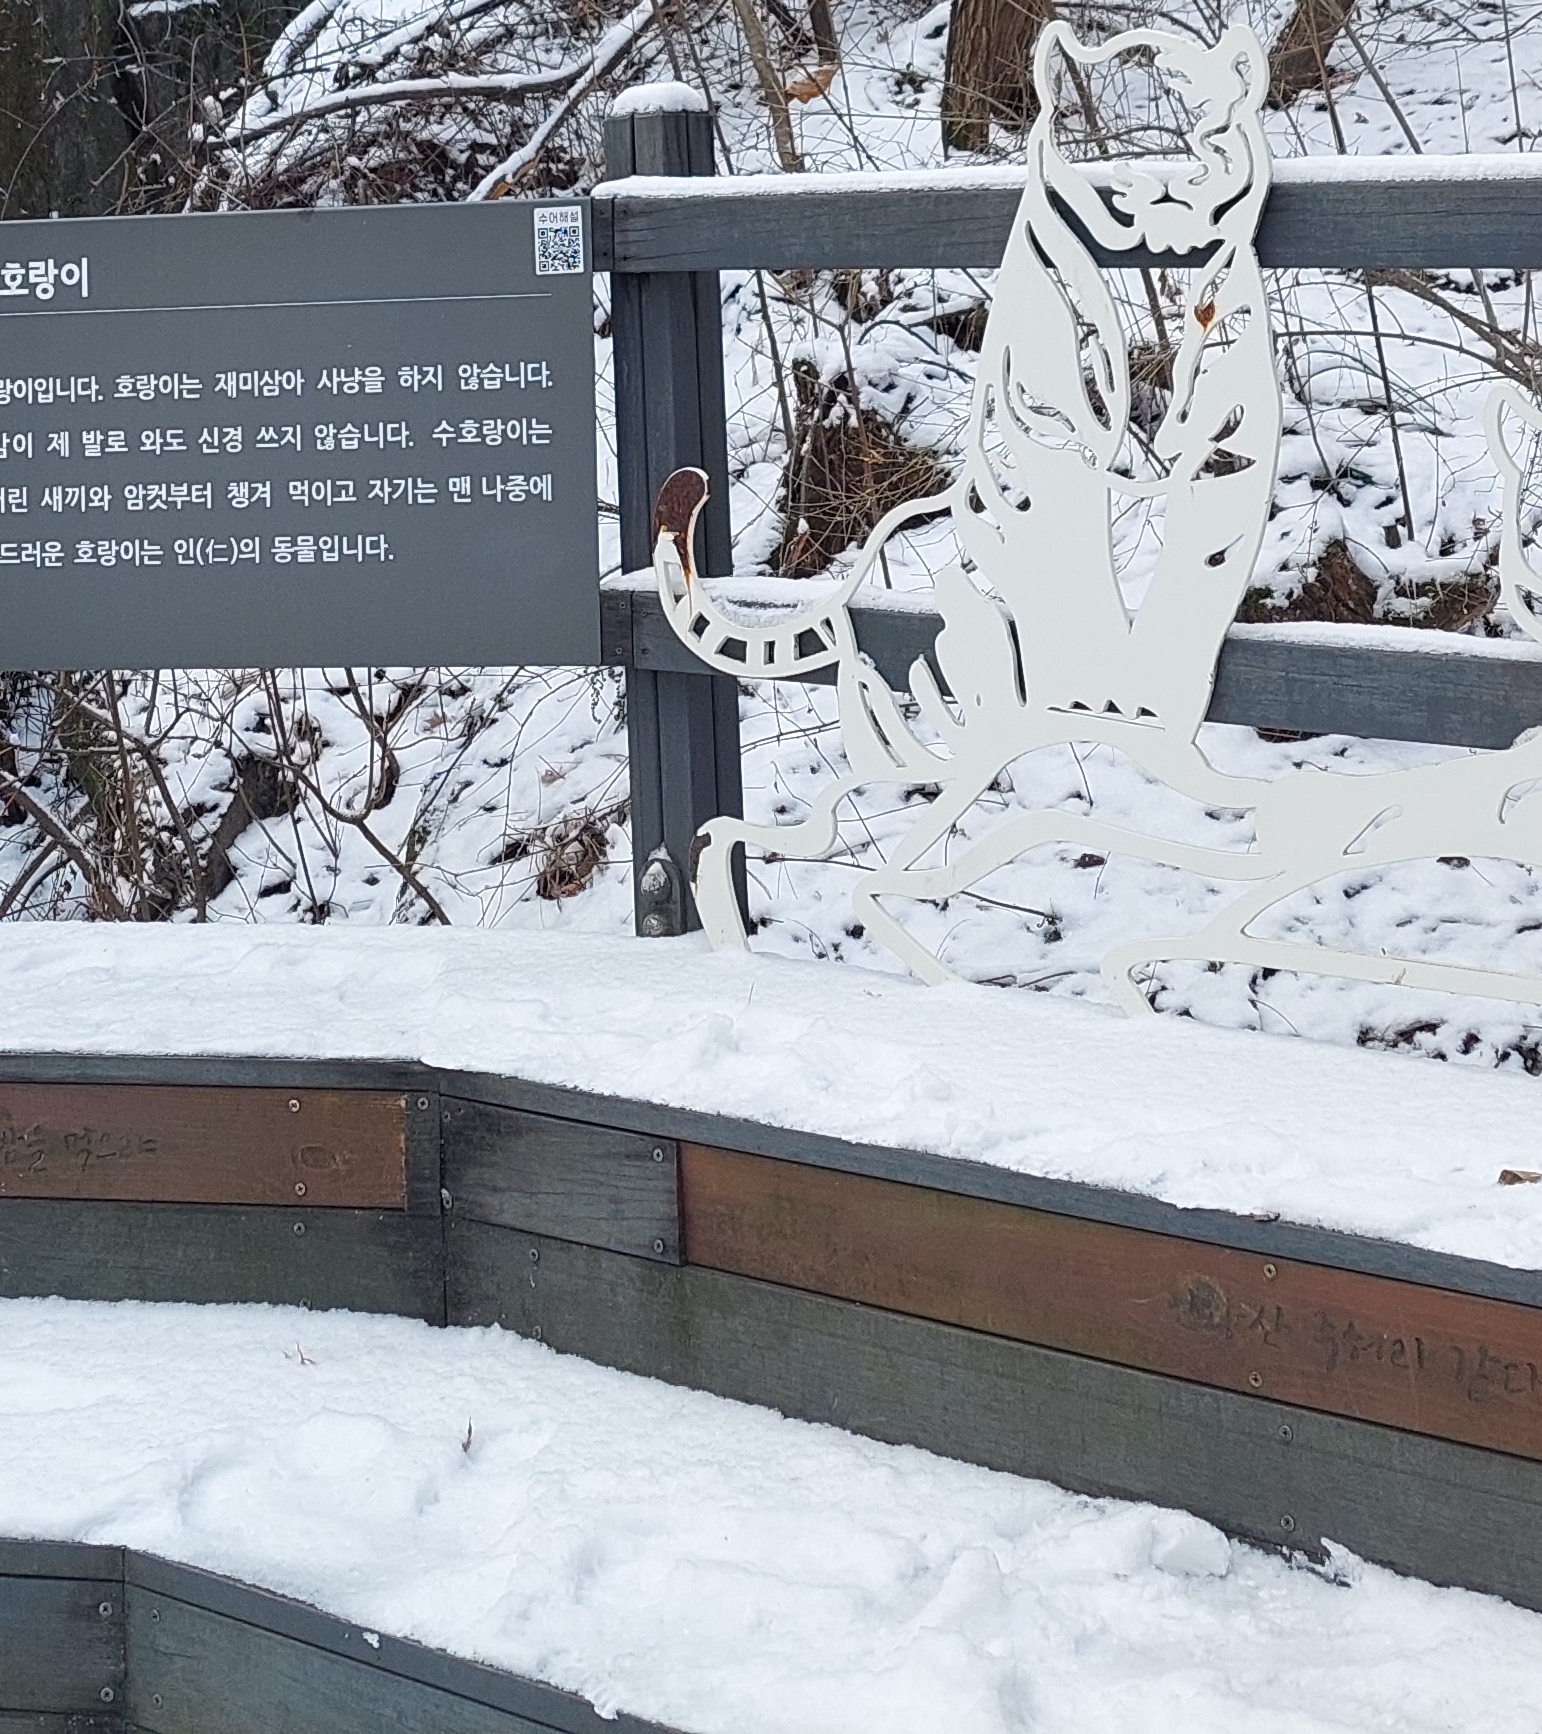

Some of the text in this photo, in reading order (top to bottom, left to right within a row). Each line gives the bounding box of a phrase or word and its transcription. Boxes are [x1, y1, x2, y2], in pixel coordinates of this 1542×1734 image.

[538, 210, 579, 225] 수어해설
[114, 373, 202, 400] 호랑이는
[215, 369, 305, 398] 재미삼아
[317, 367, 385, 394] 사냥을
[398, 365, 442, 392] 하지
[458, 361, 552, 390] 않습니다.
[47, 431, 69, 457] 제
[82, 430, 128, 456] 발로
[140, 429, 187, 455] 와도
[198, 426, 242, 453] 신경
[256, 425, 301, 451] 쓰지
[315, 422, 414, 450] 않습니다.
[432, 418, 552, 447] 수호랑이는
[41, 485, 112, 512] 새끼와
[124, 482, 211, 510] 암컷부터
[227, 481, 270, 508] 챙겨
[289, 480, 357, 506] 먹이고
[368, 477, 438, 504] 자기는
[449, 476, 471, 502] 맨
[482, 474, 552, 502] 나중에
[74, 539, 163, 566] 호랑이는
[174, 537, 259, 565] 인(仁)의
[271, 534, 393, 563] 동물입니다.
